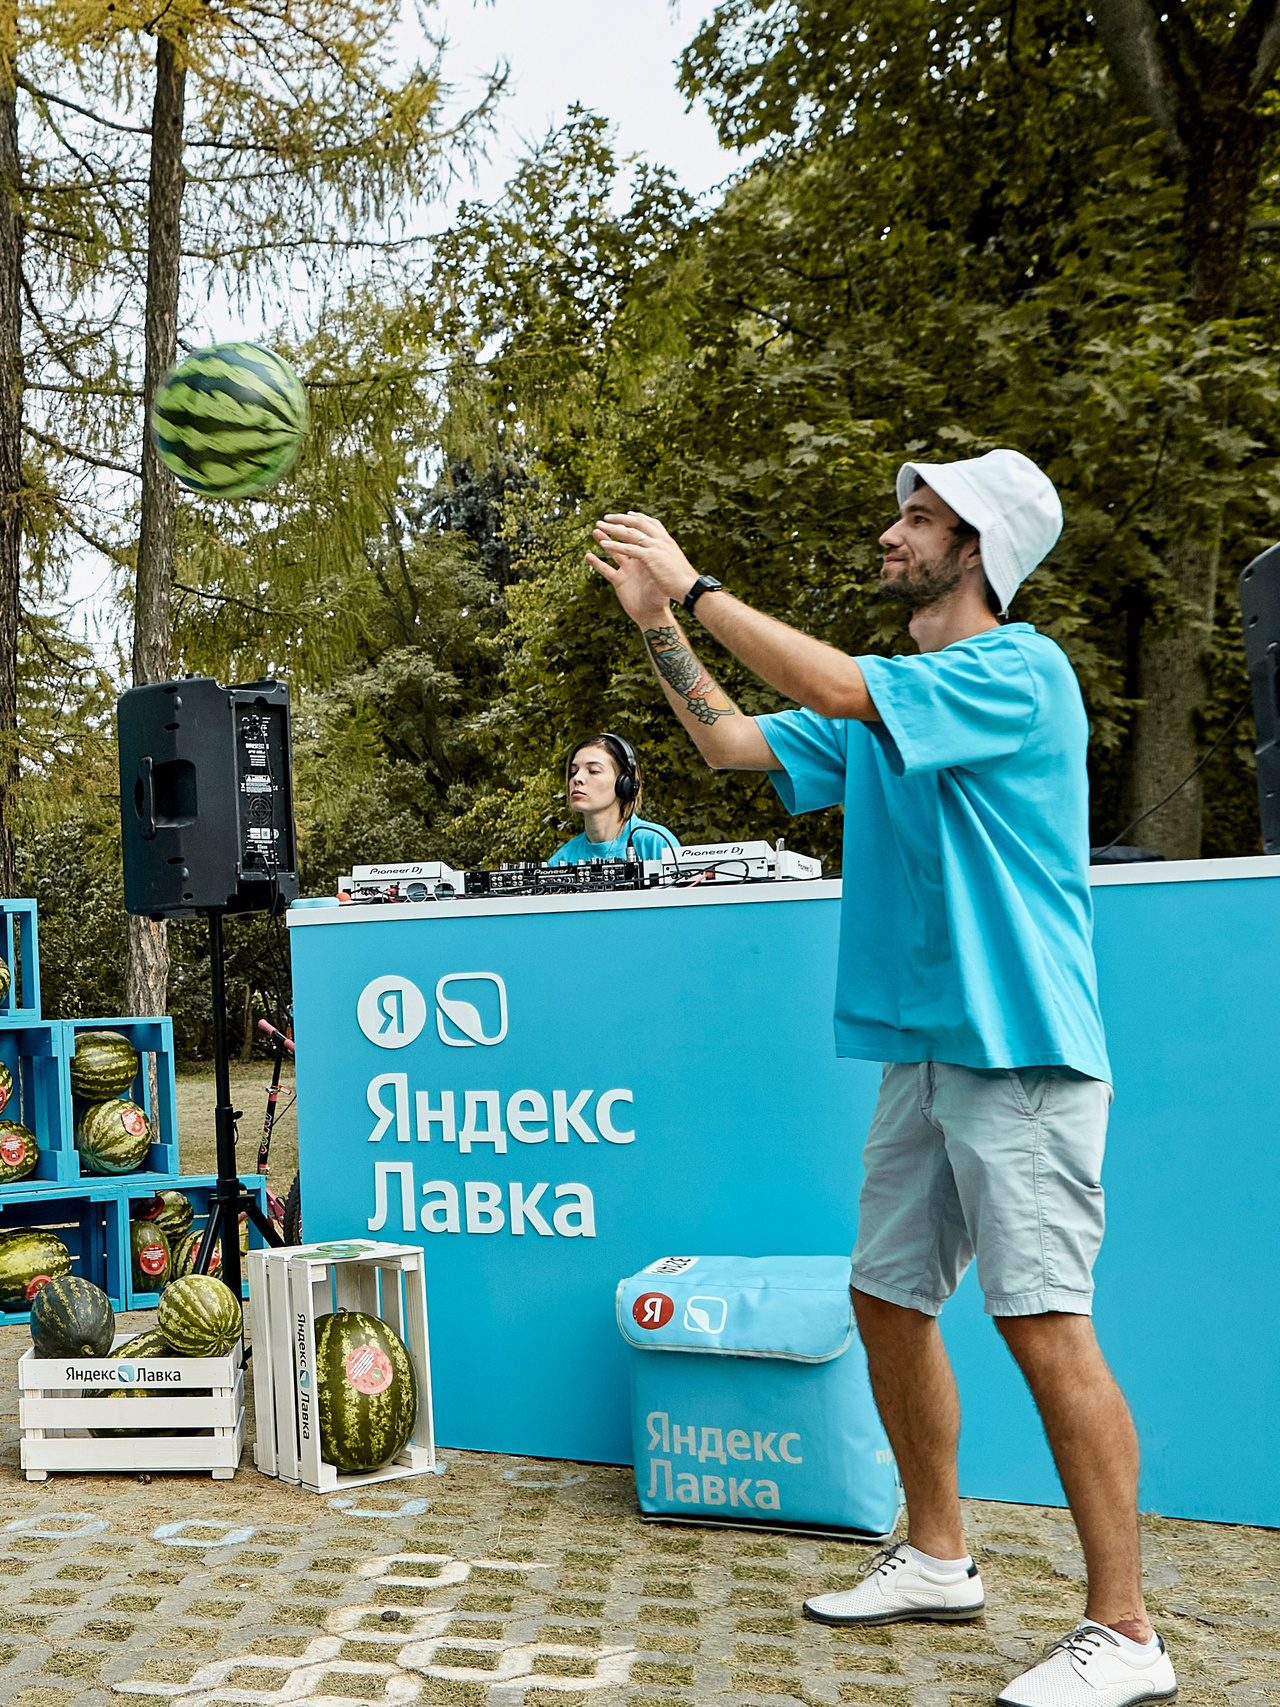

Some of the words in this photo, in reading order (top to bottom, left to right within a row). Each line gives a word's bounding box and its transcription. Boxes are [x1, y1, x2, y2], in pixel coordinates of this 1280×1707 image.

[681, 848, 729, 857] Pioneer
[366, 1072, 636, 1155] Яндекс
[367, 1161, 597, 1238] Лавка
[297, 1313, 307, 1367] Яндекс
[66, 1366, 116, 1382] Яндекс
[136, 1368, 181, 1382] Лавка
[301, 1390, 310, 1440] Лавка
[645, 1411, 803, 1465] Яндекс
[646, 1458, 781, 1510] Лавка
